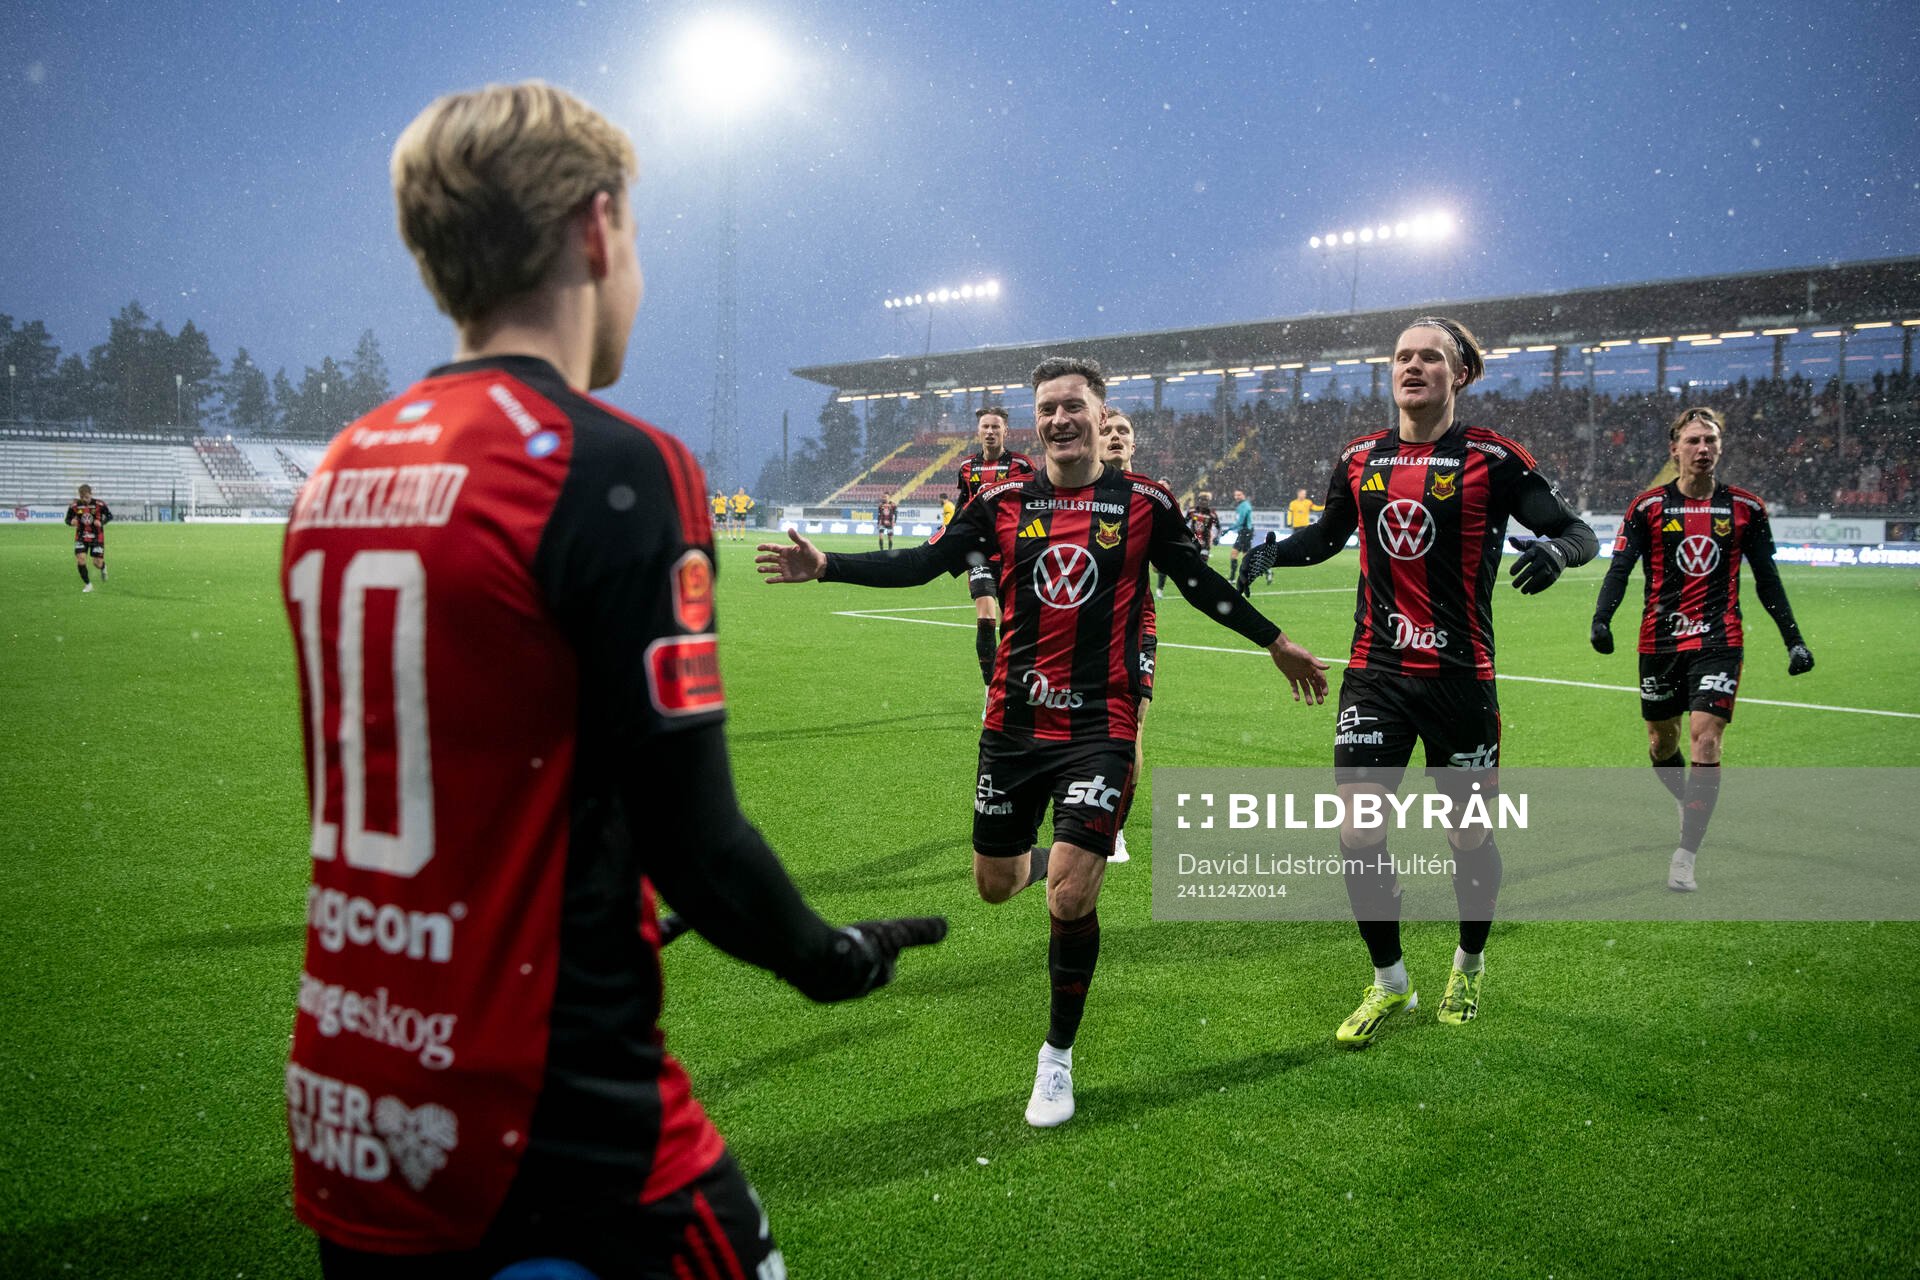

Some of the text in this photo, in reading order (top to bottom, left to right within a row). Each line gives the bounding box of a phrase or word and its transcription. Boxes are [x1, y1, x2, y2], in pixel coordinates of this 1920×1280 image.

[1388, 613, 1448, 649] Diös
[1022, 669, 1084, 709] Diös
[1699, 672, 1738, 695] stc
[290, 550, 435, 878] 10
[1063, 775, 1121, 812] stc
